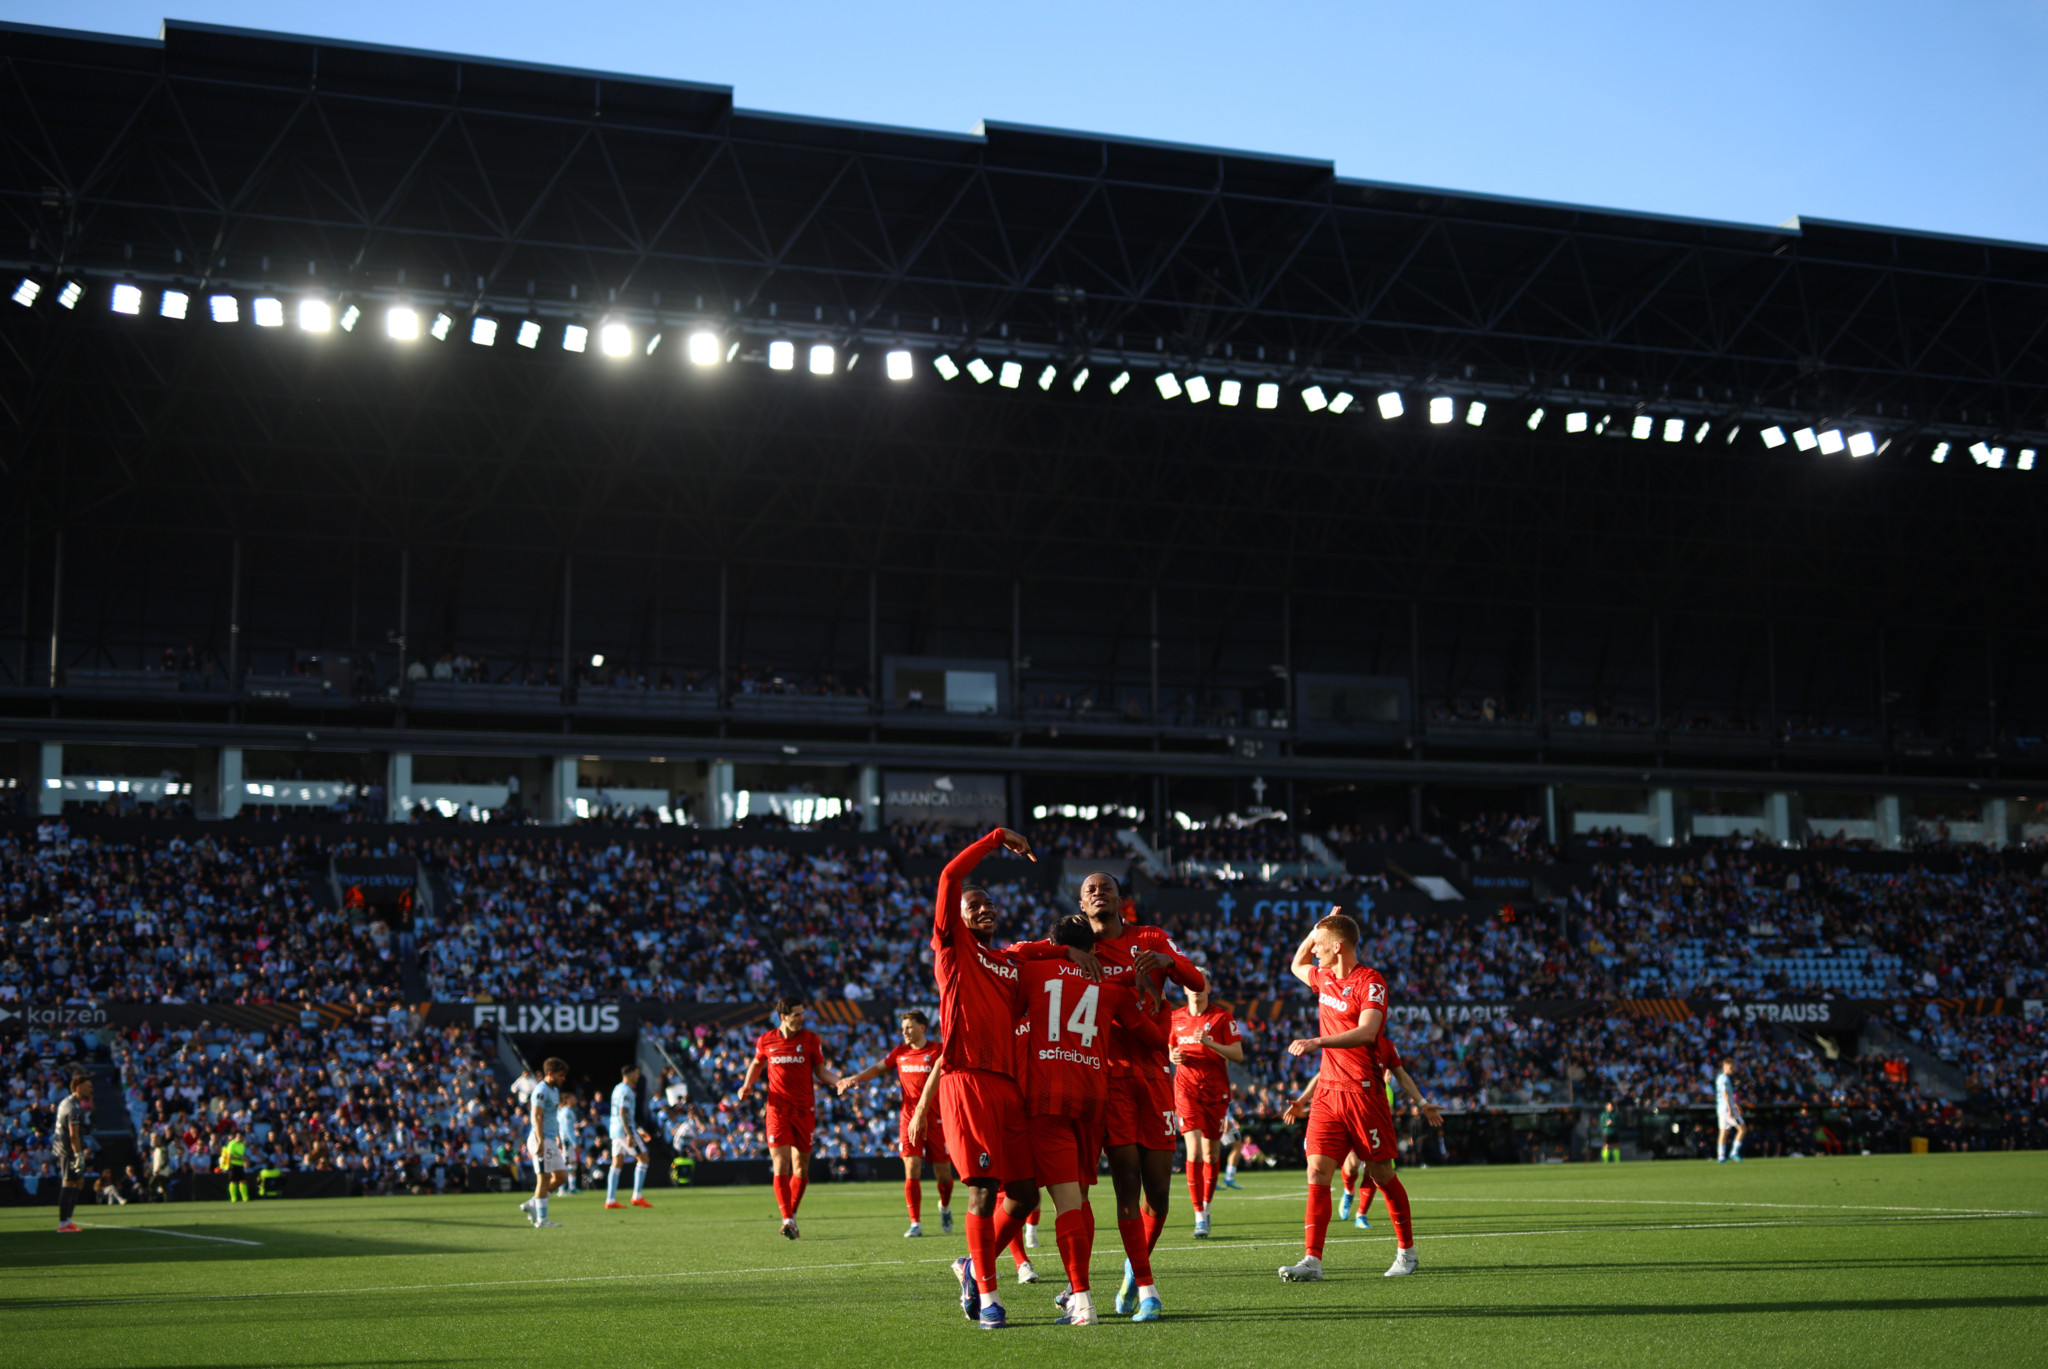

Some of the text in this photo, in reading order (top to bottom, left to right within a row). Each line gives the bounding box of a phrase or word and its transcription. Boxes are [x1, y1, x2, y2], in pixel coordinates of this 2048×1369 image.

[27, 1006, 107, 1023] kaizen
[1044, 979, 1100, 1047] 14
[1745, 1003, 1830, 1022] STRAUSS
[1369, 1128, 1381, 1149] 3
